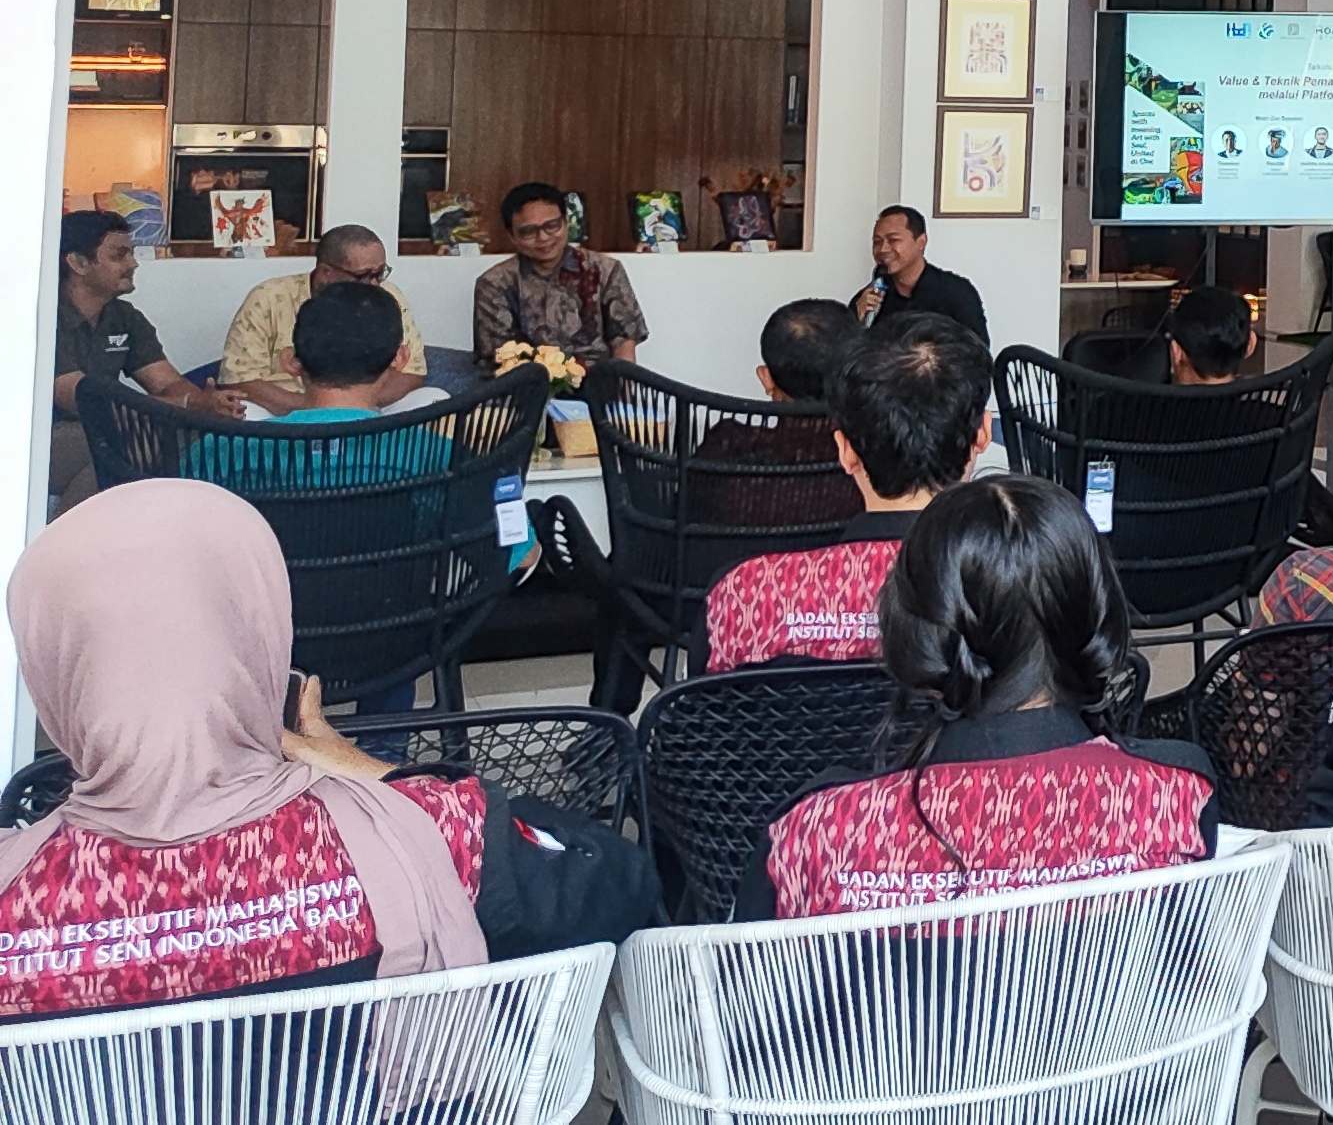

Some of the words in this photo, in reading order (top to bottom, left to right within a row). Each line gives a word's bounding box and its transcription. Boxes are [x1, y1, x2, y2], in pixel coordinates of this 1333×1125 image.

[1219, 76, 1248, 86] Value
[1252, 76, 1260, 85] &
[1265, 76, 1300, 85] Teknik
[1259, 90, 1299, 99] melalui
[786, 612, 837, 625] BADAN
[788, 626, 852, 640] INSTITUT
[838, 871, 905, 889] BADAN
[1019, 853, 1138, 882] MAHASISWA
[840, 889, 928, 907] INSTITUT
[63, 908, 196, 944] EKSEKUTIF
[206, 875, 362, 926] MAHASISWA
[95, 939, 151, 965] SENI
[158, 916, 298, 954] INDONESIA
[306, 897, 359, 927] BALI
